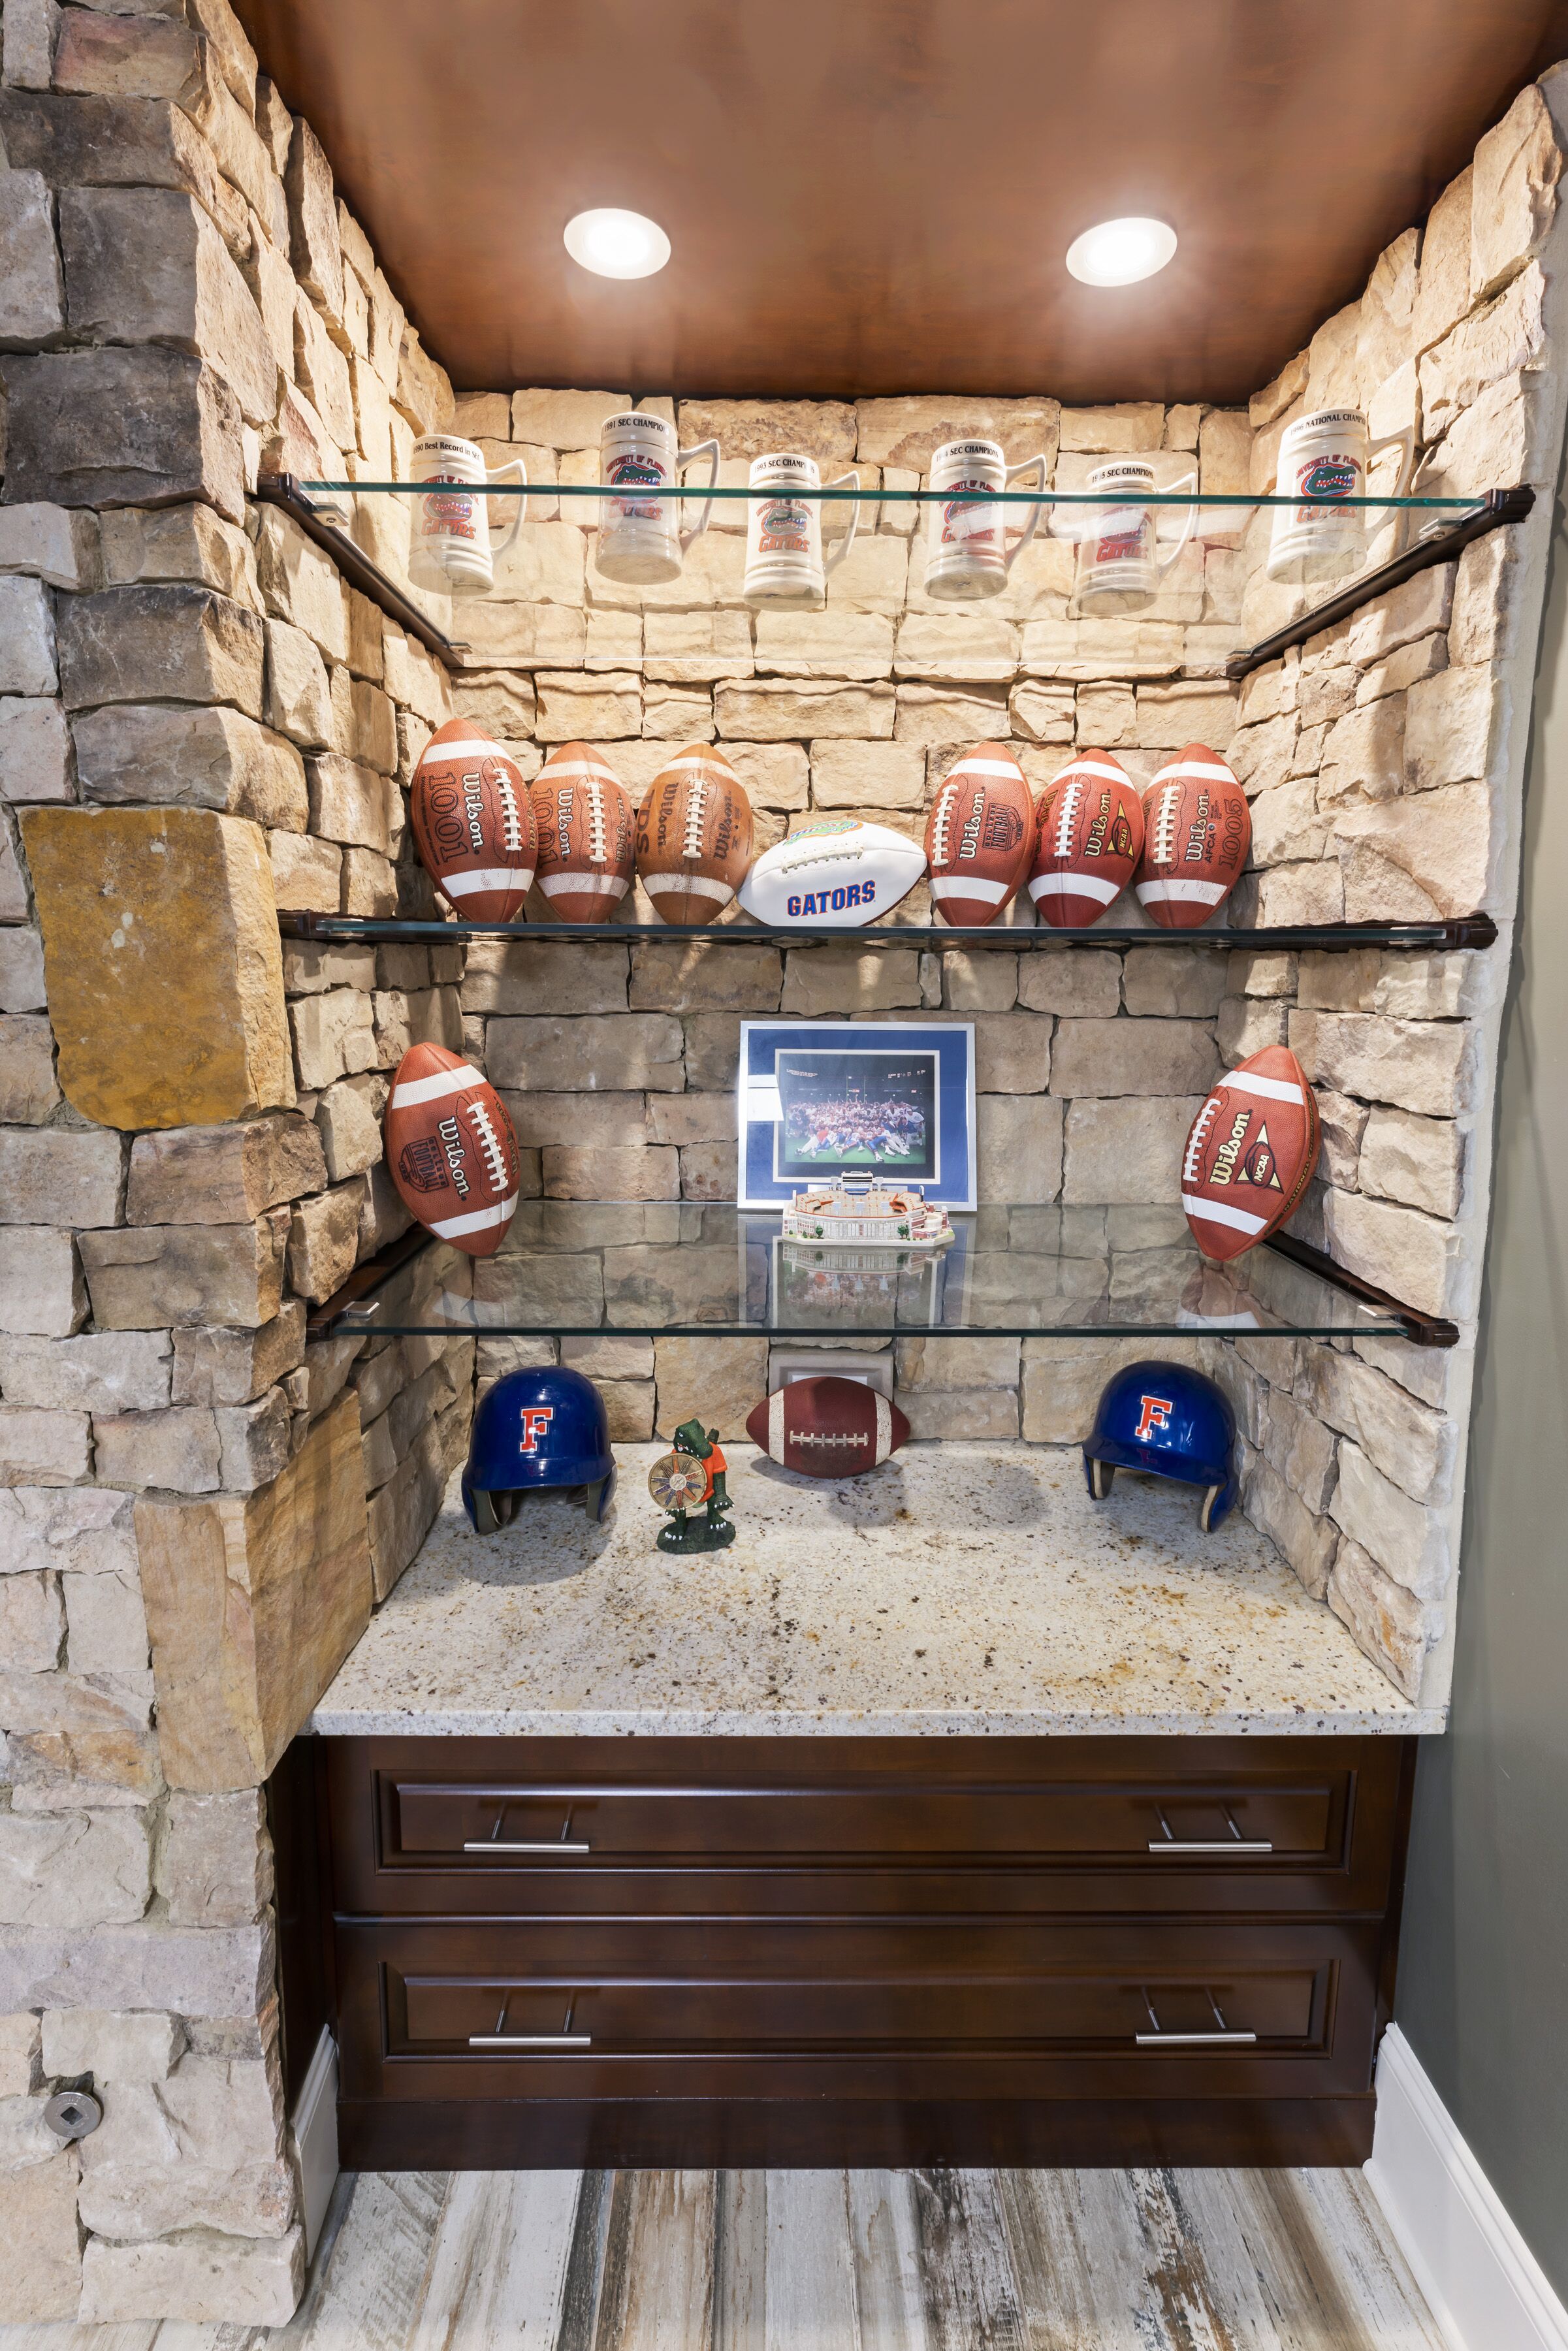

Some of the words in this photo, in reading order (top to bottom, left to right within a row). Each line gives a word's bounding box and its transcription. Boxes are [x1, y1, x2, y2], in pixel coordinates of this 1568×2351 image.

[605, 421, 616, 432] 1991
[618, 418, 632, 427] SEC
[1290, 423, 1304, 436] 1996
[1305, 413, 1341, 429] NATIONAL
[413, 443, 424, 455] 1990
[440, 441, 464, 453] Record
[465, 447, 471, 455] in
[755, 462, 767, 473] 1993
[768, 459, 781, 468] SEC
[950, 446, 963, 456] SEC
[965, 445, 999, 458] CHAMPIONS
[1107, 468, 1120, 477] SEC
[1122, 467, 1154, 479] CHAMPIONS
[421, 519, 477, 539] GATORS
[758, 535, 810, 554] GATORS
[428, 772, 468, 863] 1001
[462, 772, 485, 848] Wilson
[558, 787, 573, 856] Wilson
[615, 798, 628, 863] Wilson
[658, 782, 679, 848] Wilson
[713, 795, 733, 859] Wilson
[959, 792, 986, 859] Wilson
[990, 807, 1010, 848] FOOTBALL
[1084, 793, 1112, 857] Wilson
[1185, 793, 1209, 861] Wilson
[1119, 827, 1128, 849] NCAA
[1204, 833, 1216, 863] AFCA
[1218, 798, 1243, 870] 1005
[787, 880, 876, 917] GATORS
[411, 1142, 440, 1189] FOOTBALL
[438, 1116, 471, 1196] Wilson
[1209, 1112, 1251, 1185] Wilson
[1253, 1153, 1270, 1183] NCAA
[1283, 1161, 1311, 1212] NATIONAL
[520, 1407, 554, 1453] F
[1135, 1395, 1174, 1440] F
